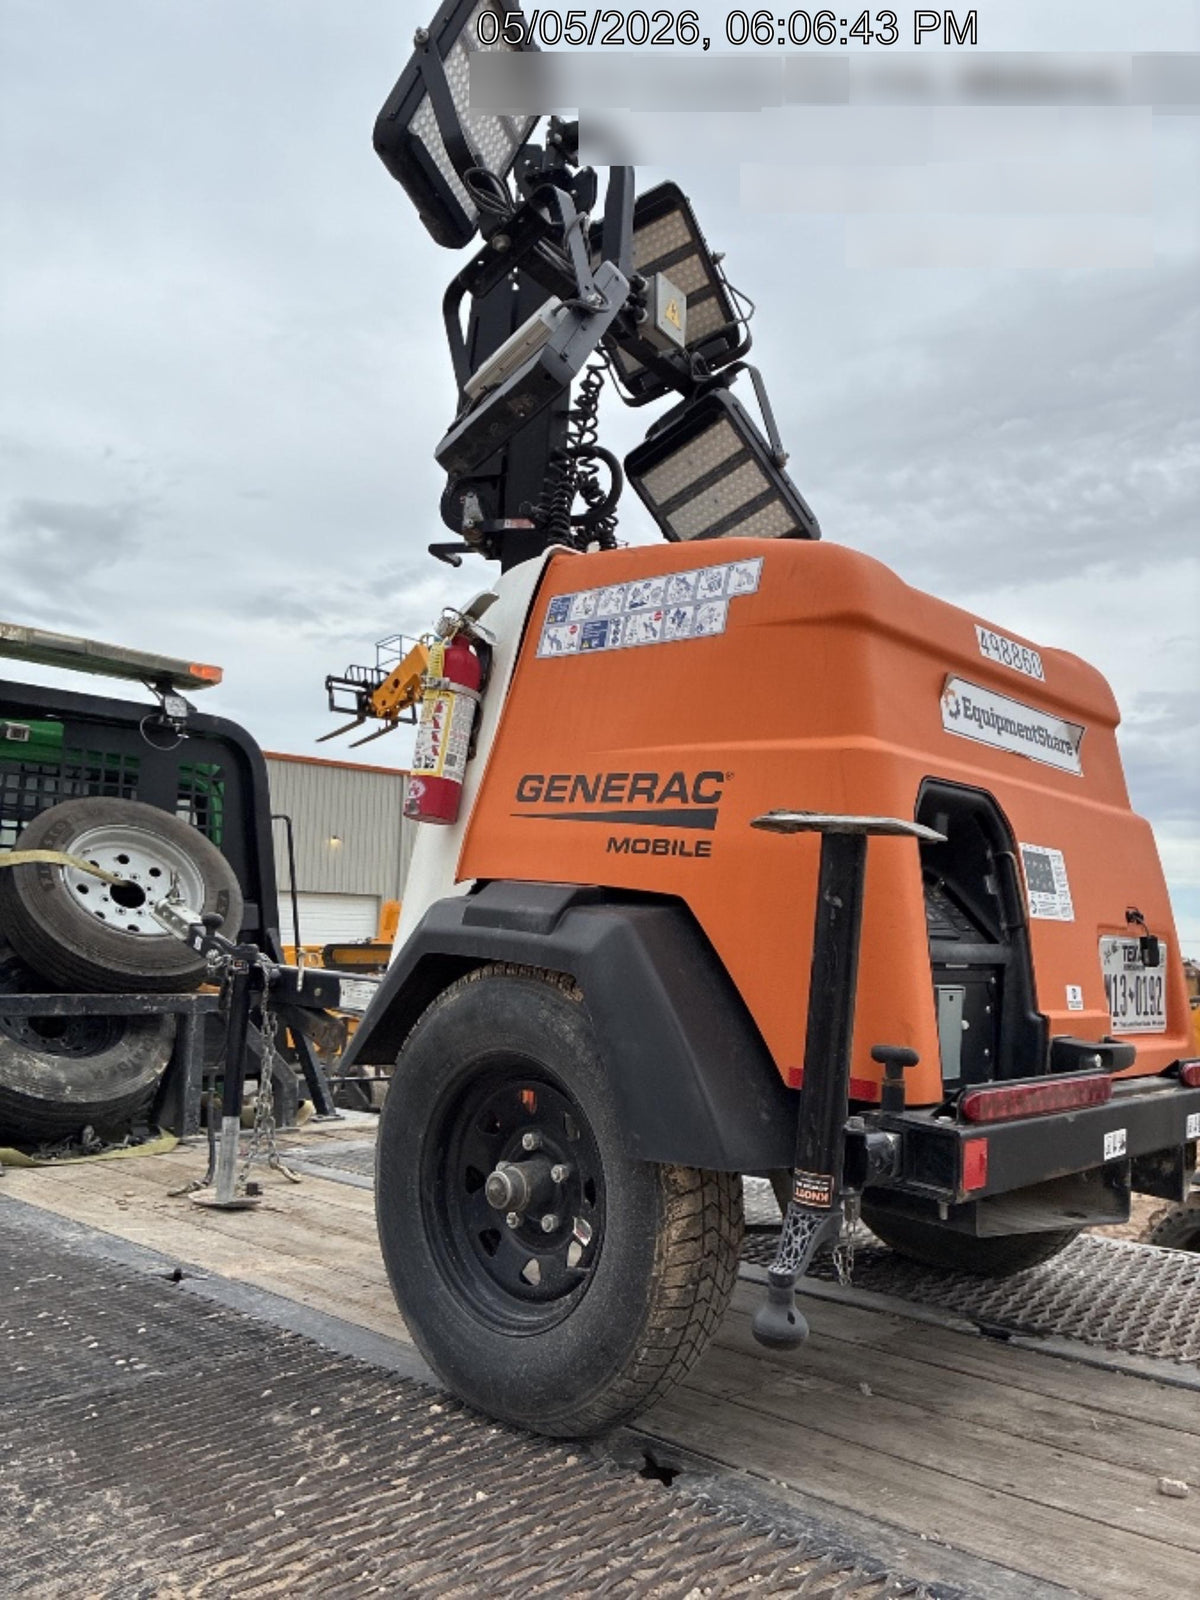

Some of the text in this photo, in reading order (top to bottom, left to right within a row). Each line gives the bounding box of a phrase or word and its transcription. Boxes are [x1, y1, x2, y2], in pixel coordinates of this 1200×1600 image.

[980, 629, 1044, 679] 498860
[961, 696, 1073, 757] EquipmentShare
[515, 771, 725, 804] GENERAC
[606, 837, 713, 858] MOBILE
